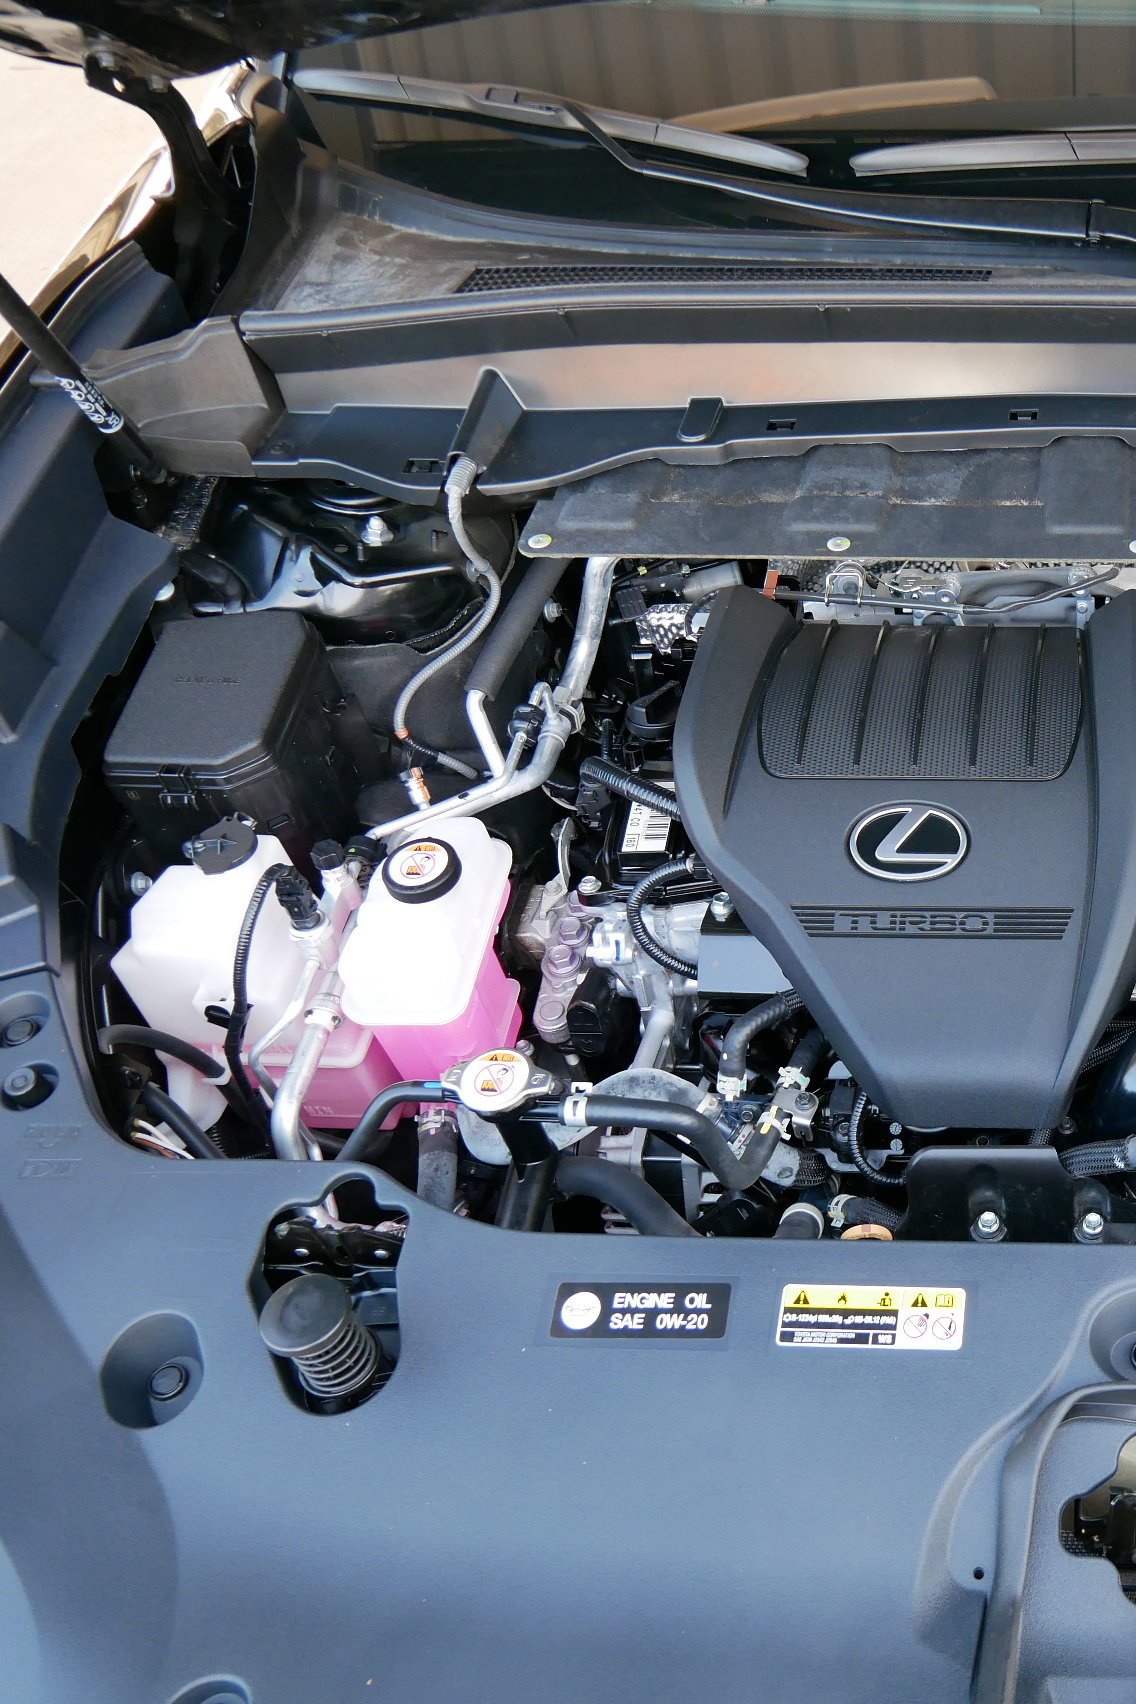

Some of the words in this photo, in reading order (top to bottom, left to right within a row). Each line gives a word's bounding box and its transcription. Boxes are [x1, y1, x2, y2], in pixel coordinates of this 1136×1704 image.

[625, 837, 637, 848] 160
[839, 911, 989, 933] TURBO
[612, 1292, 675, 1309] ENGINE
[684, 1293, 712, 1309] OIL
[609, 1313, 645, 1329] SAE
[656, 1313, 709, 1330] 0W-20
